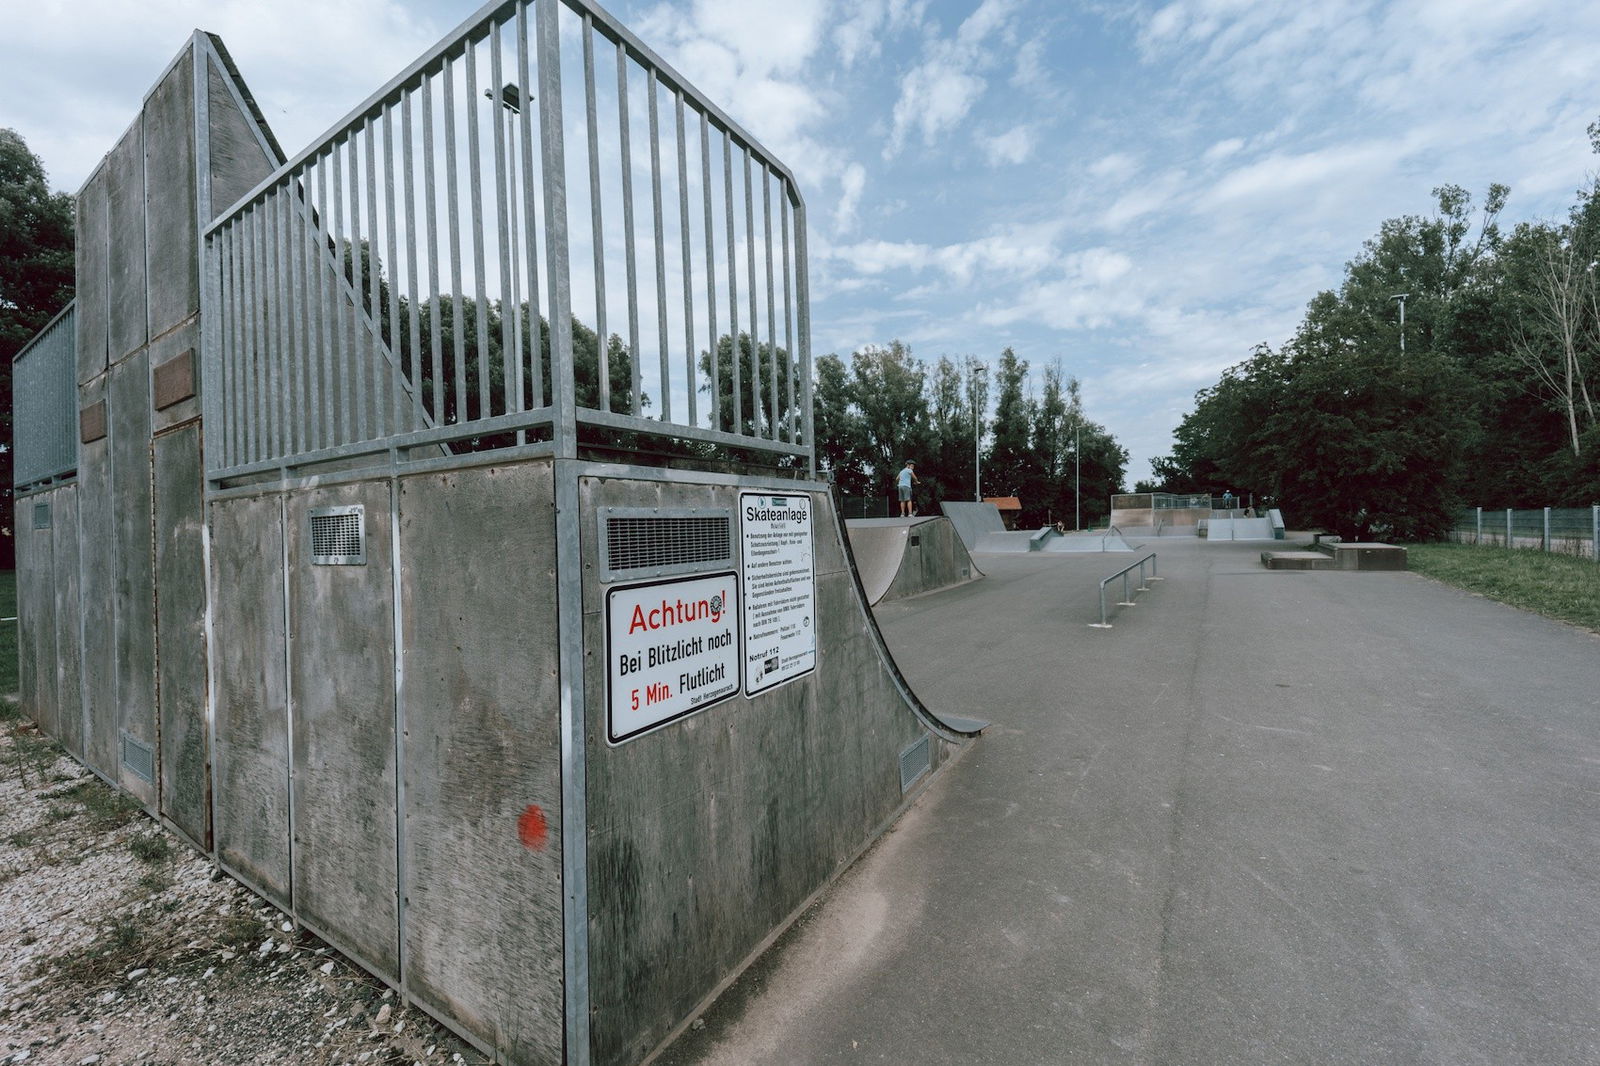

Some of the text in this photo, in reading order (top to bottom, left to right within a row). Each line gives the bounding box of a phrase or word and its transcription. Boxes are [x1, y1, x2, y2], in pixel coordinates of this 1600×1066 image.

[746, 507, 807, 524] Skateanlage
[620, 651, 641, 676] Bei
[648, 635, 703, 668] Blitzlicht
[708, 628, 732, 651] noch
[749, 646, 779, 662] Notruf 112
[631, 662, 725, 711] 5 Min. Flutlicht
[690, 695, 702, 705] Stadt
